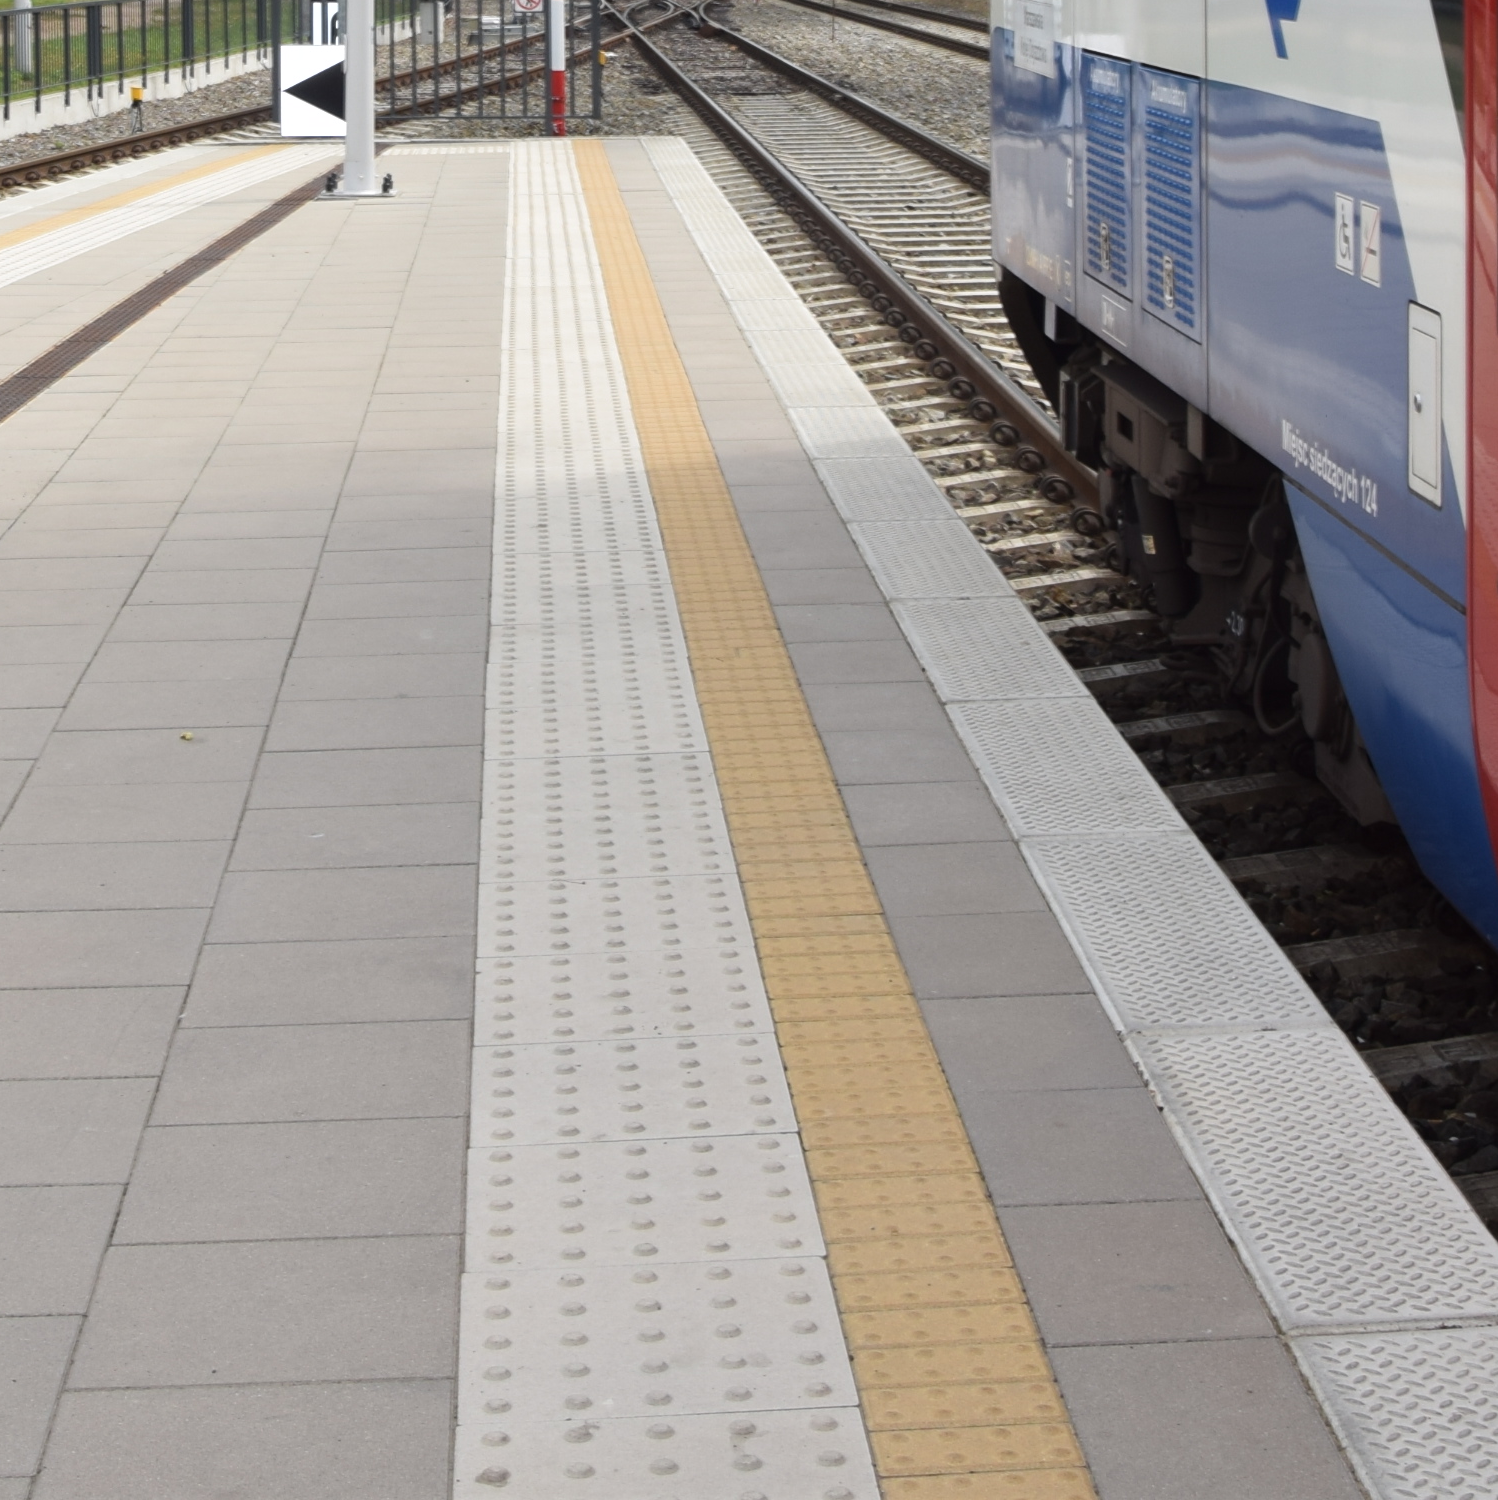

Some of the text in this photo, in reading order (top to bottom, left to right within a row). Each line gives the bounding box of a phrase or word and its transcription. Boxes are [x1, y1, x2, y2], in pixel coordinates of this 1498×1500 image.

[1282, 419, 1378, 518] Miejsc siedzących 124
